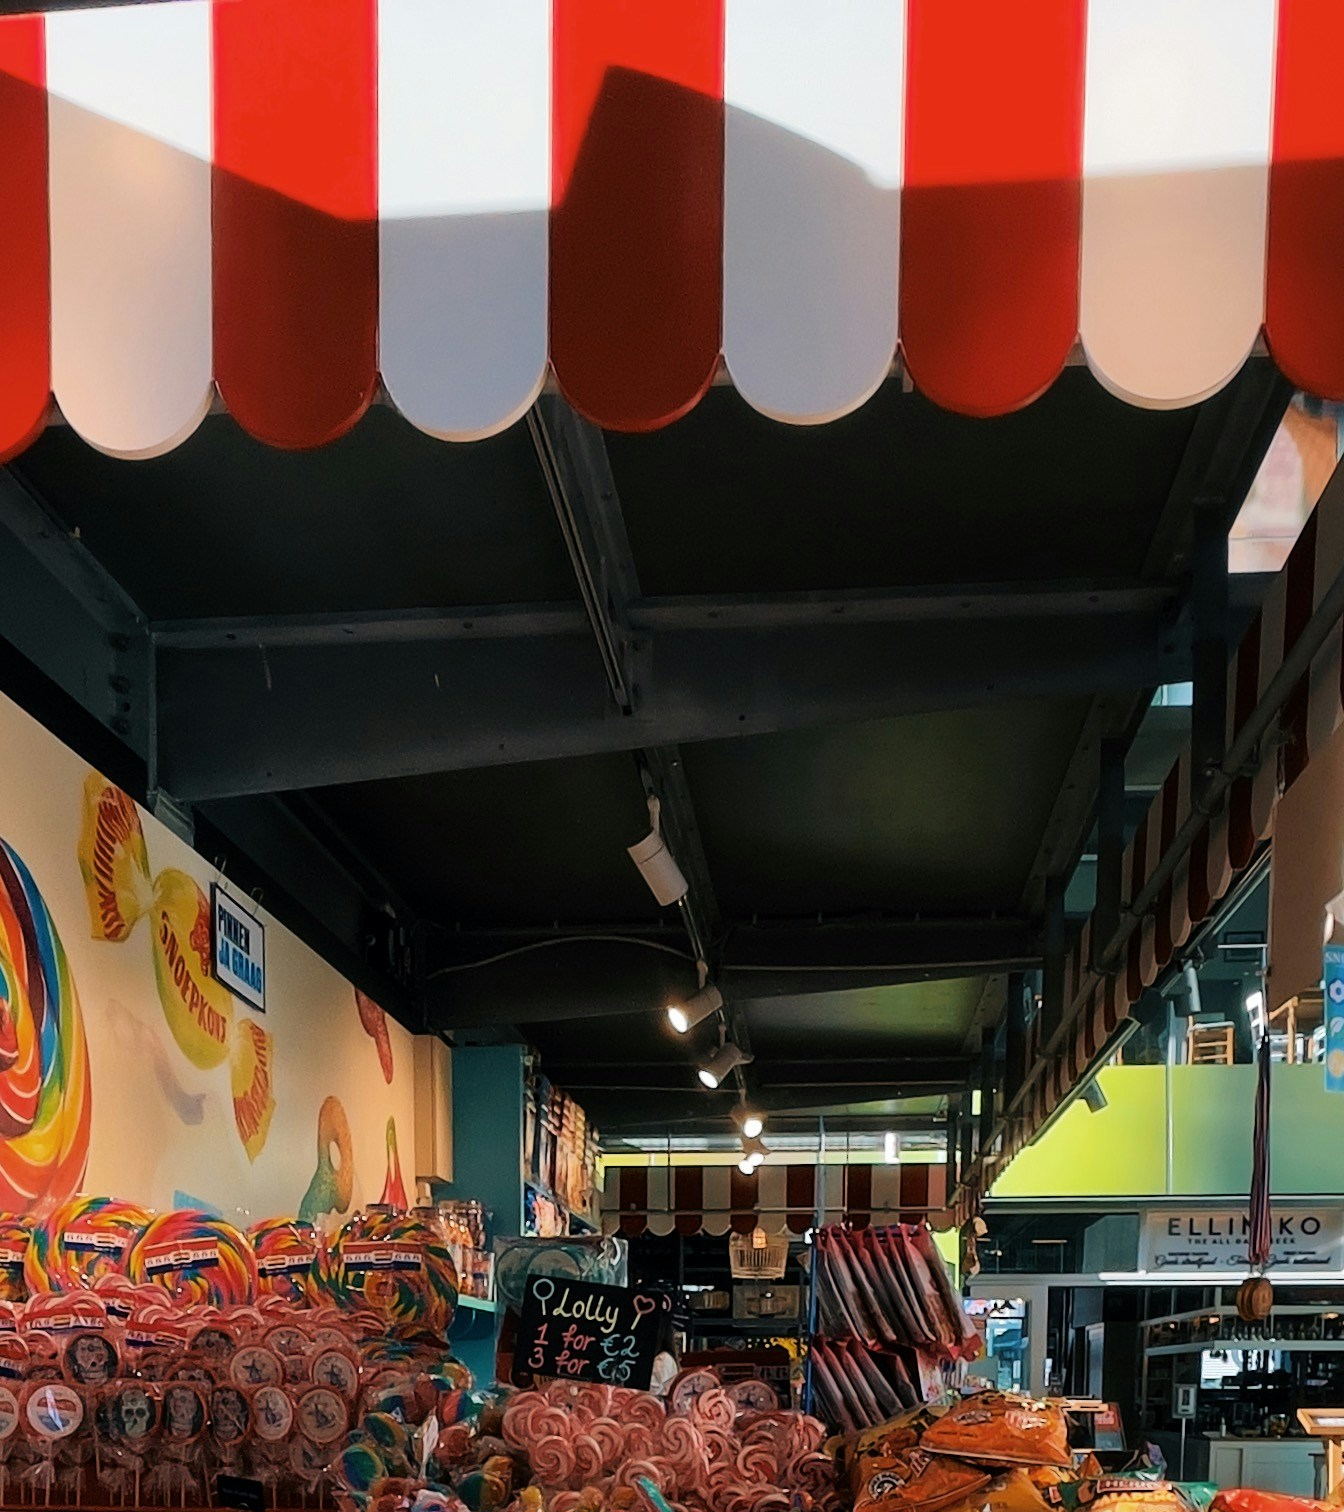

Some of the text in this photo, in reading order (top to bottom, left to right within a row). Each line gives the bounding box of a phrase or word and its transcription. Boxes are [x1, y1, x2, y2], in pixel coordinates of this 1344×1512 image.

[1168, 1217, 1321, 1236] ELLINKO
[552, 1288, 619, 1334] Lolly
[533, 1322, 640, 1358] 1 for €2
[528, 1347, 636, 1381] 3 for €5
